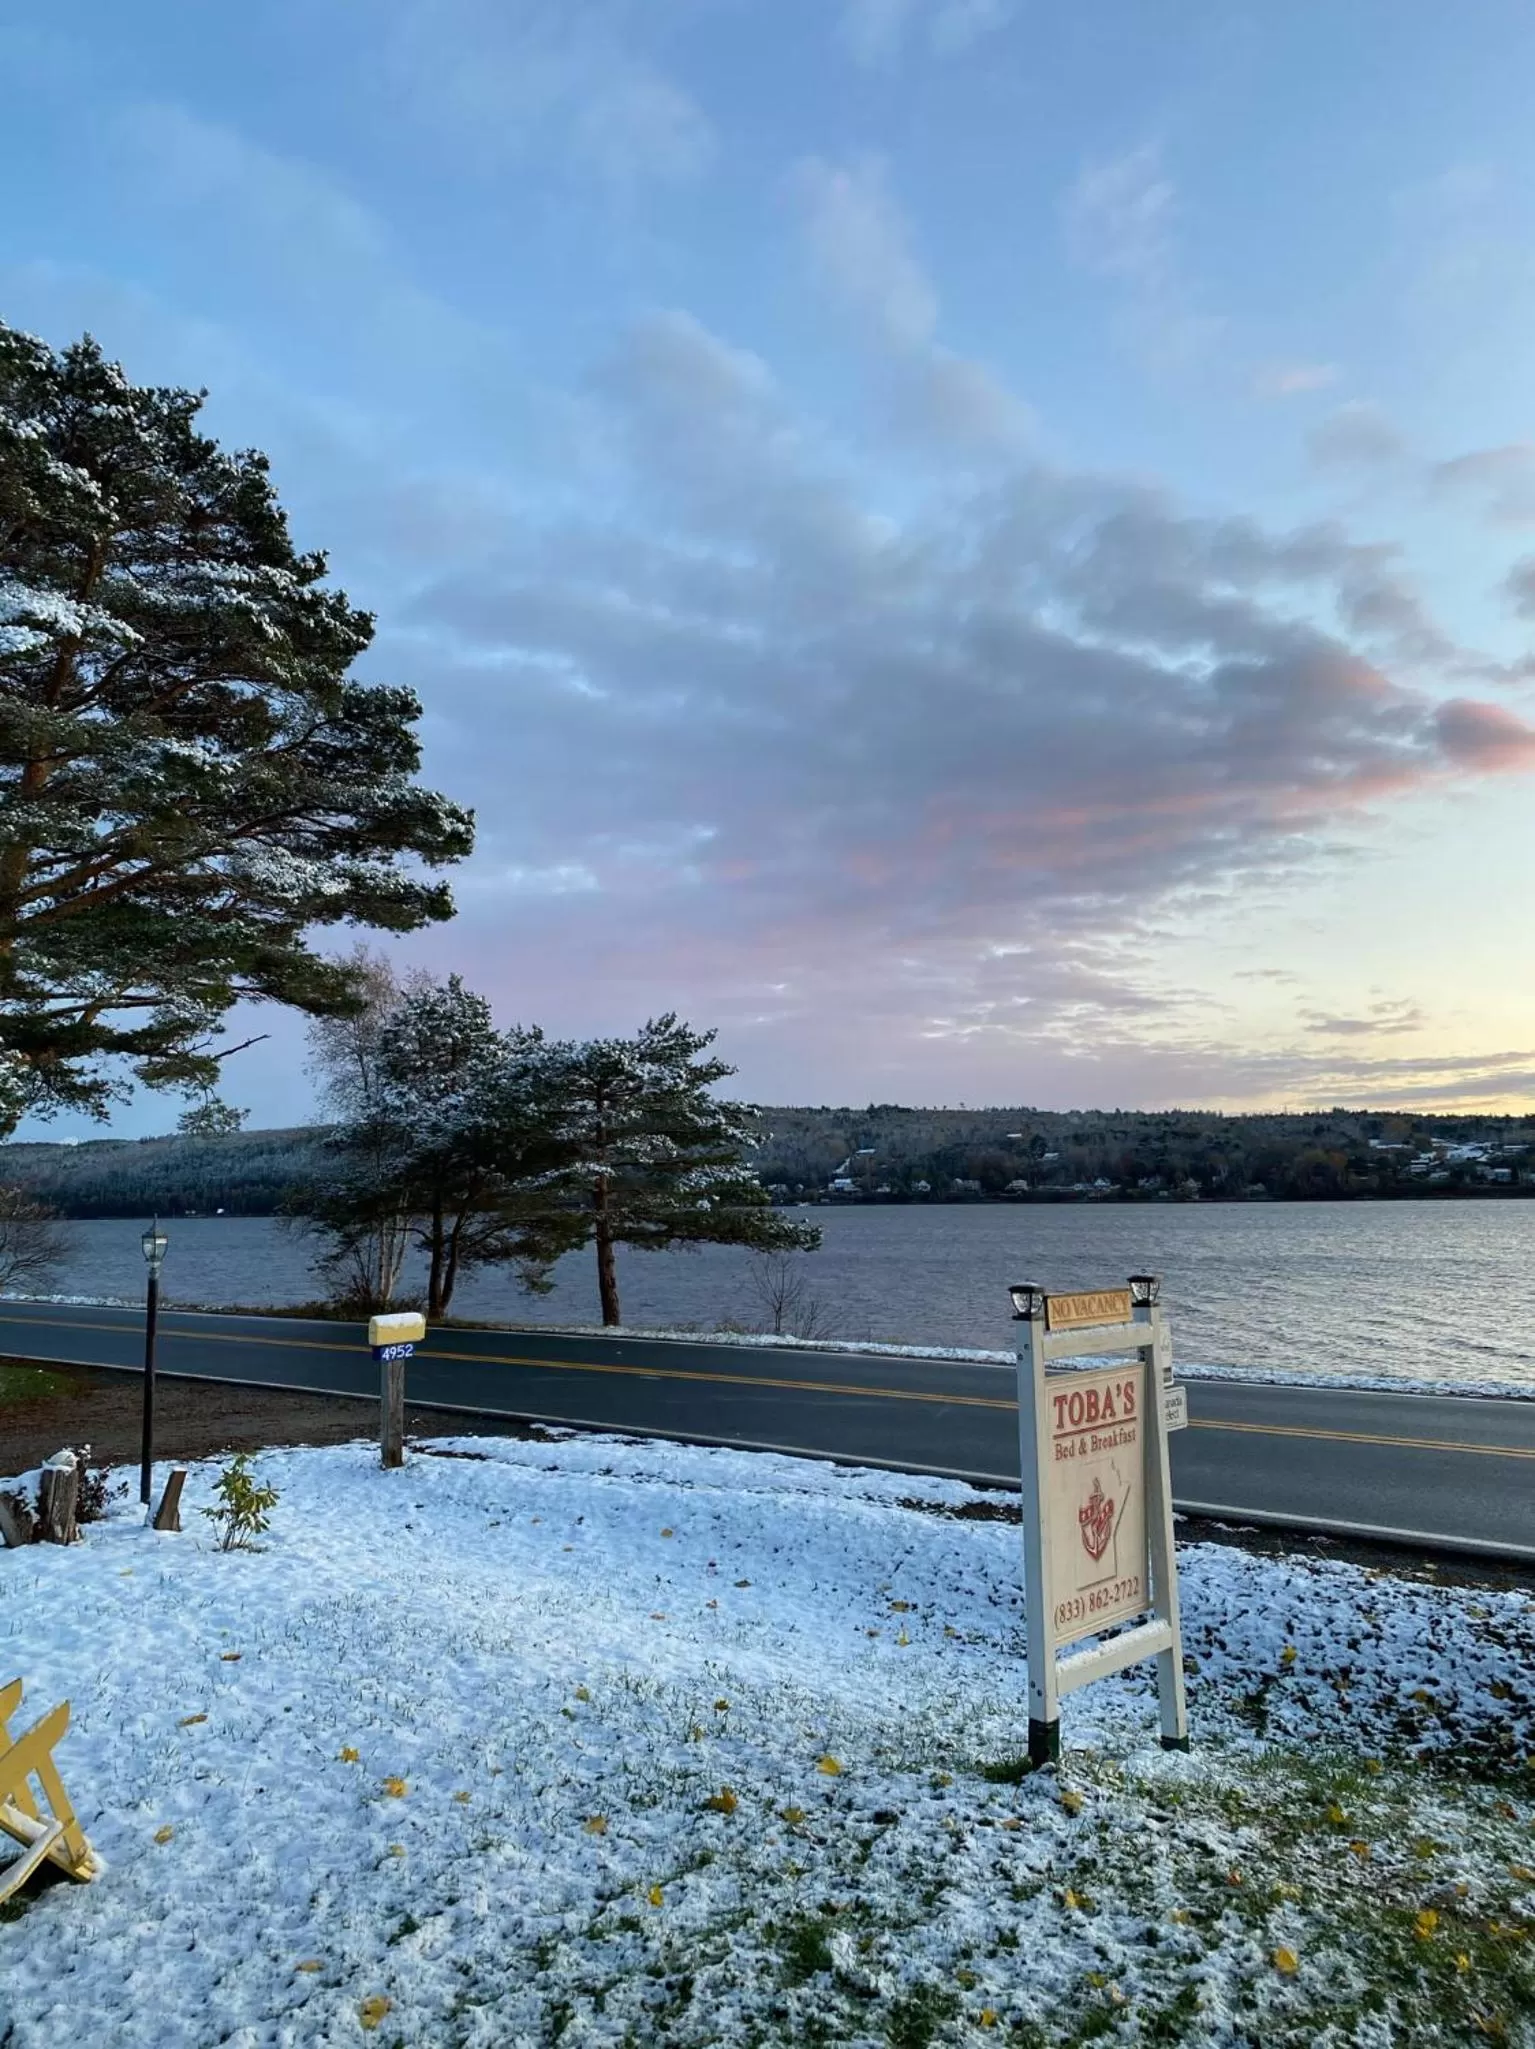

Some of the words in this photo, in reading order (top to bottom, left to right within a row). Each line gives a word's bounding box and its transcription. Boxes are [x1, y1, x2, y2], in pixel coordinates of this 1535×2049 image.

[1052, 1299, 1071, 1319] NO
[1072, 1294, 1129, 1316] VACANCY
[382, 1343, 414, 1360] 4952
[1053, 1381, 1135, 1430] TOBA'S
[1055, 1439, 1075, 1461] Bed
[1078, 1441, 1087, 1456] &
[1090, 1427, 1137, 1453] Breakfast
[1054, 1596, 1086, 1630] (833)
[1089, 1576, 1140, 1613] 862-2722
